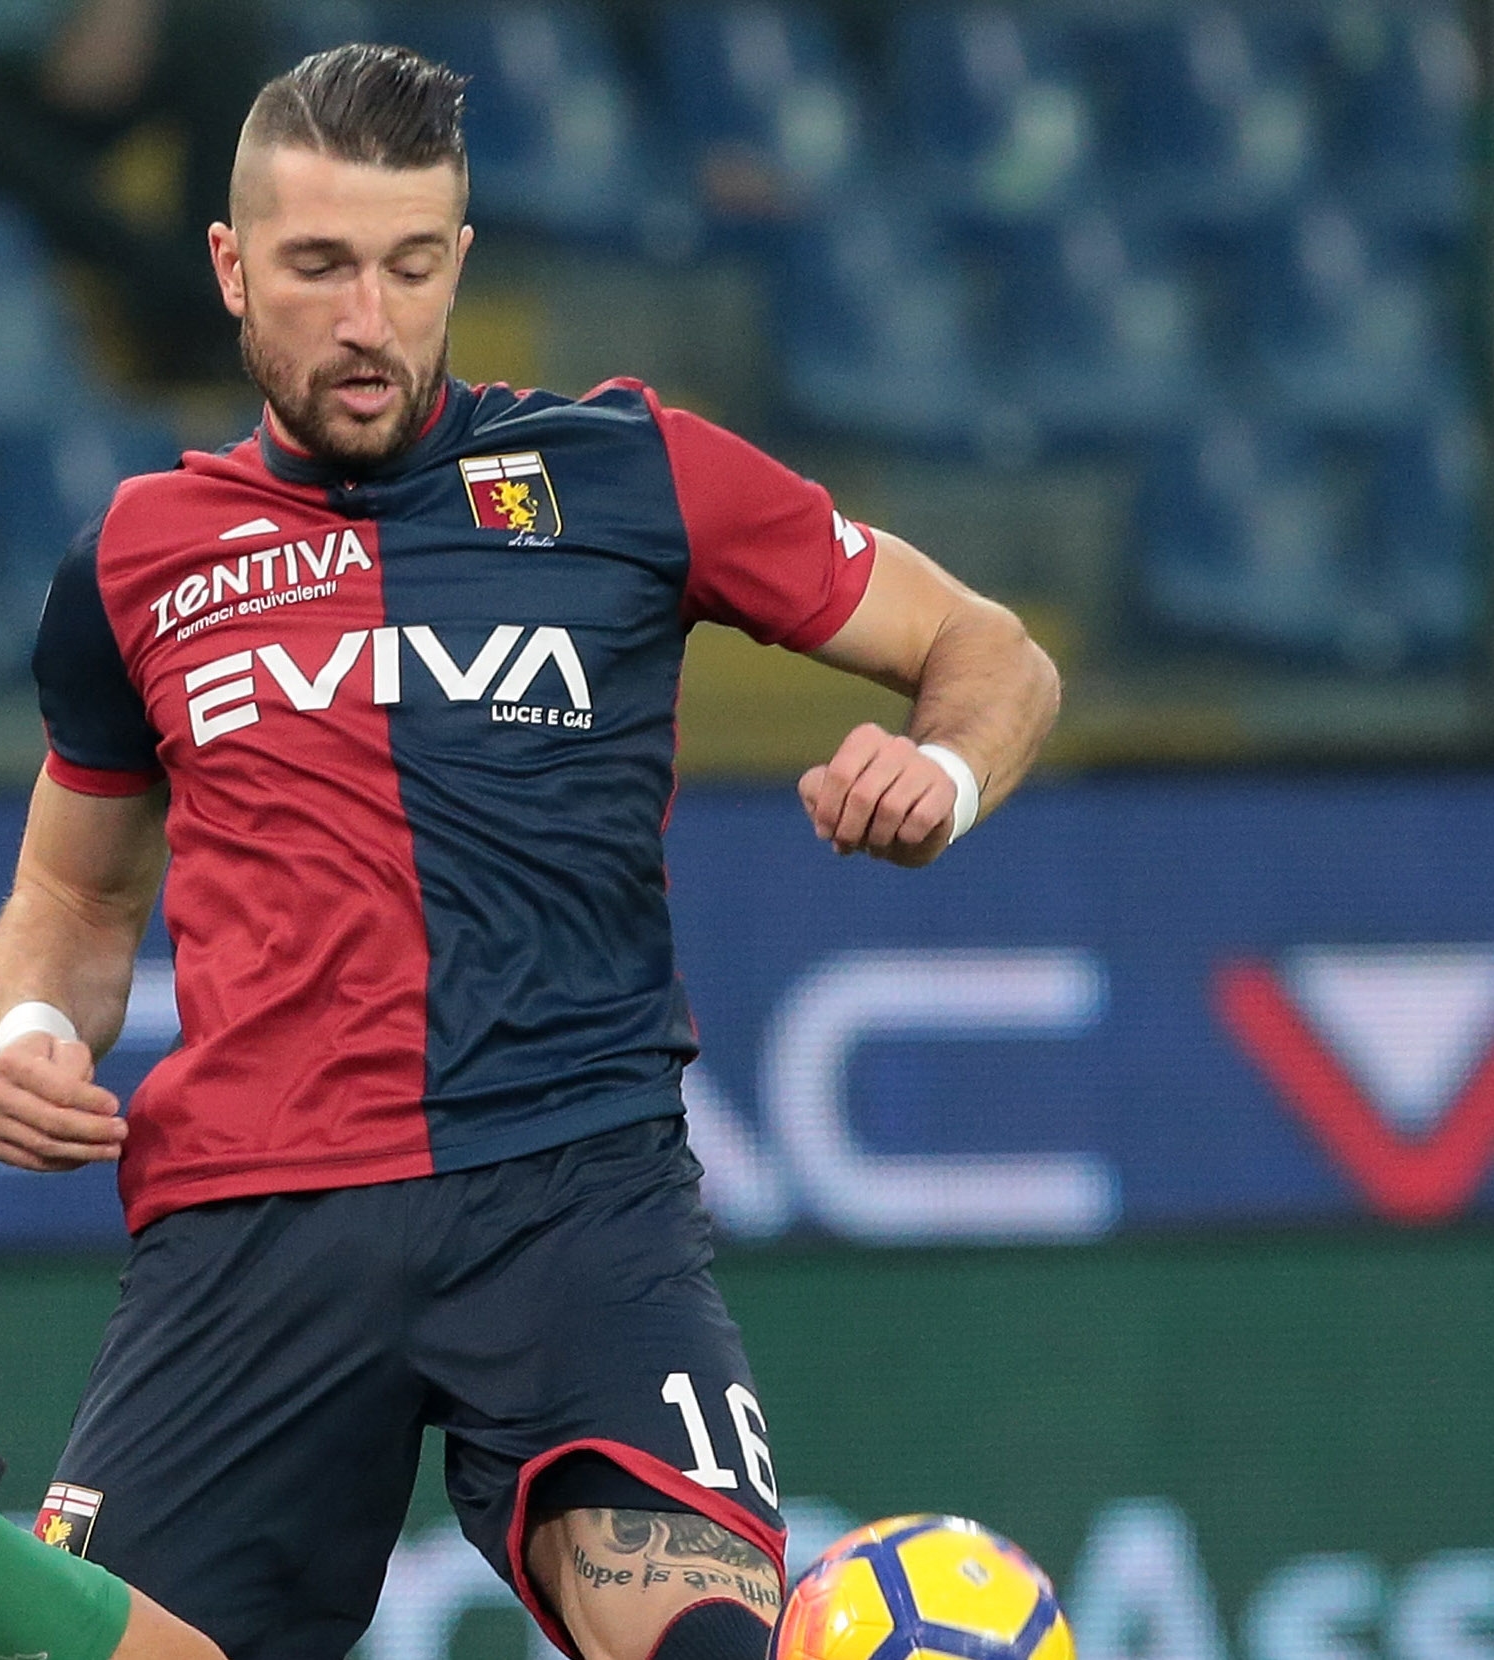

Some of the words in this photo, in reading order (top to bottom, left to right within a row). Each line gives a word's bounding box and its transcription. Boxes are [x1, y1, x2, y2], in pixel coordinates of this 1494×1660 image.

[177, 604, 234, 642] farmaci
[238, 580, 338, 615] equivalenti
[184, 624, 593, 748] EVIVA
[491, 704, 543, 723] LUCE
[547, 708, 560, 725] E
[562, 710, 593, 730] GAS
[660, 1372, 779, 1510] 16
[572, 1544, 633, 1589] Hope
[642, 1563, 671, 1590] is
